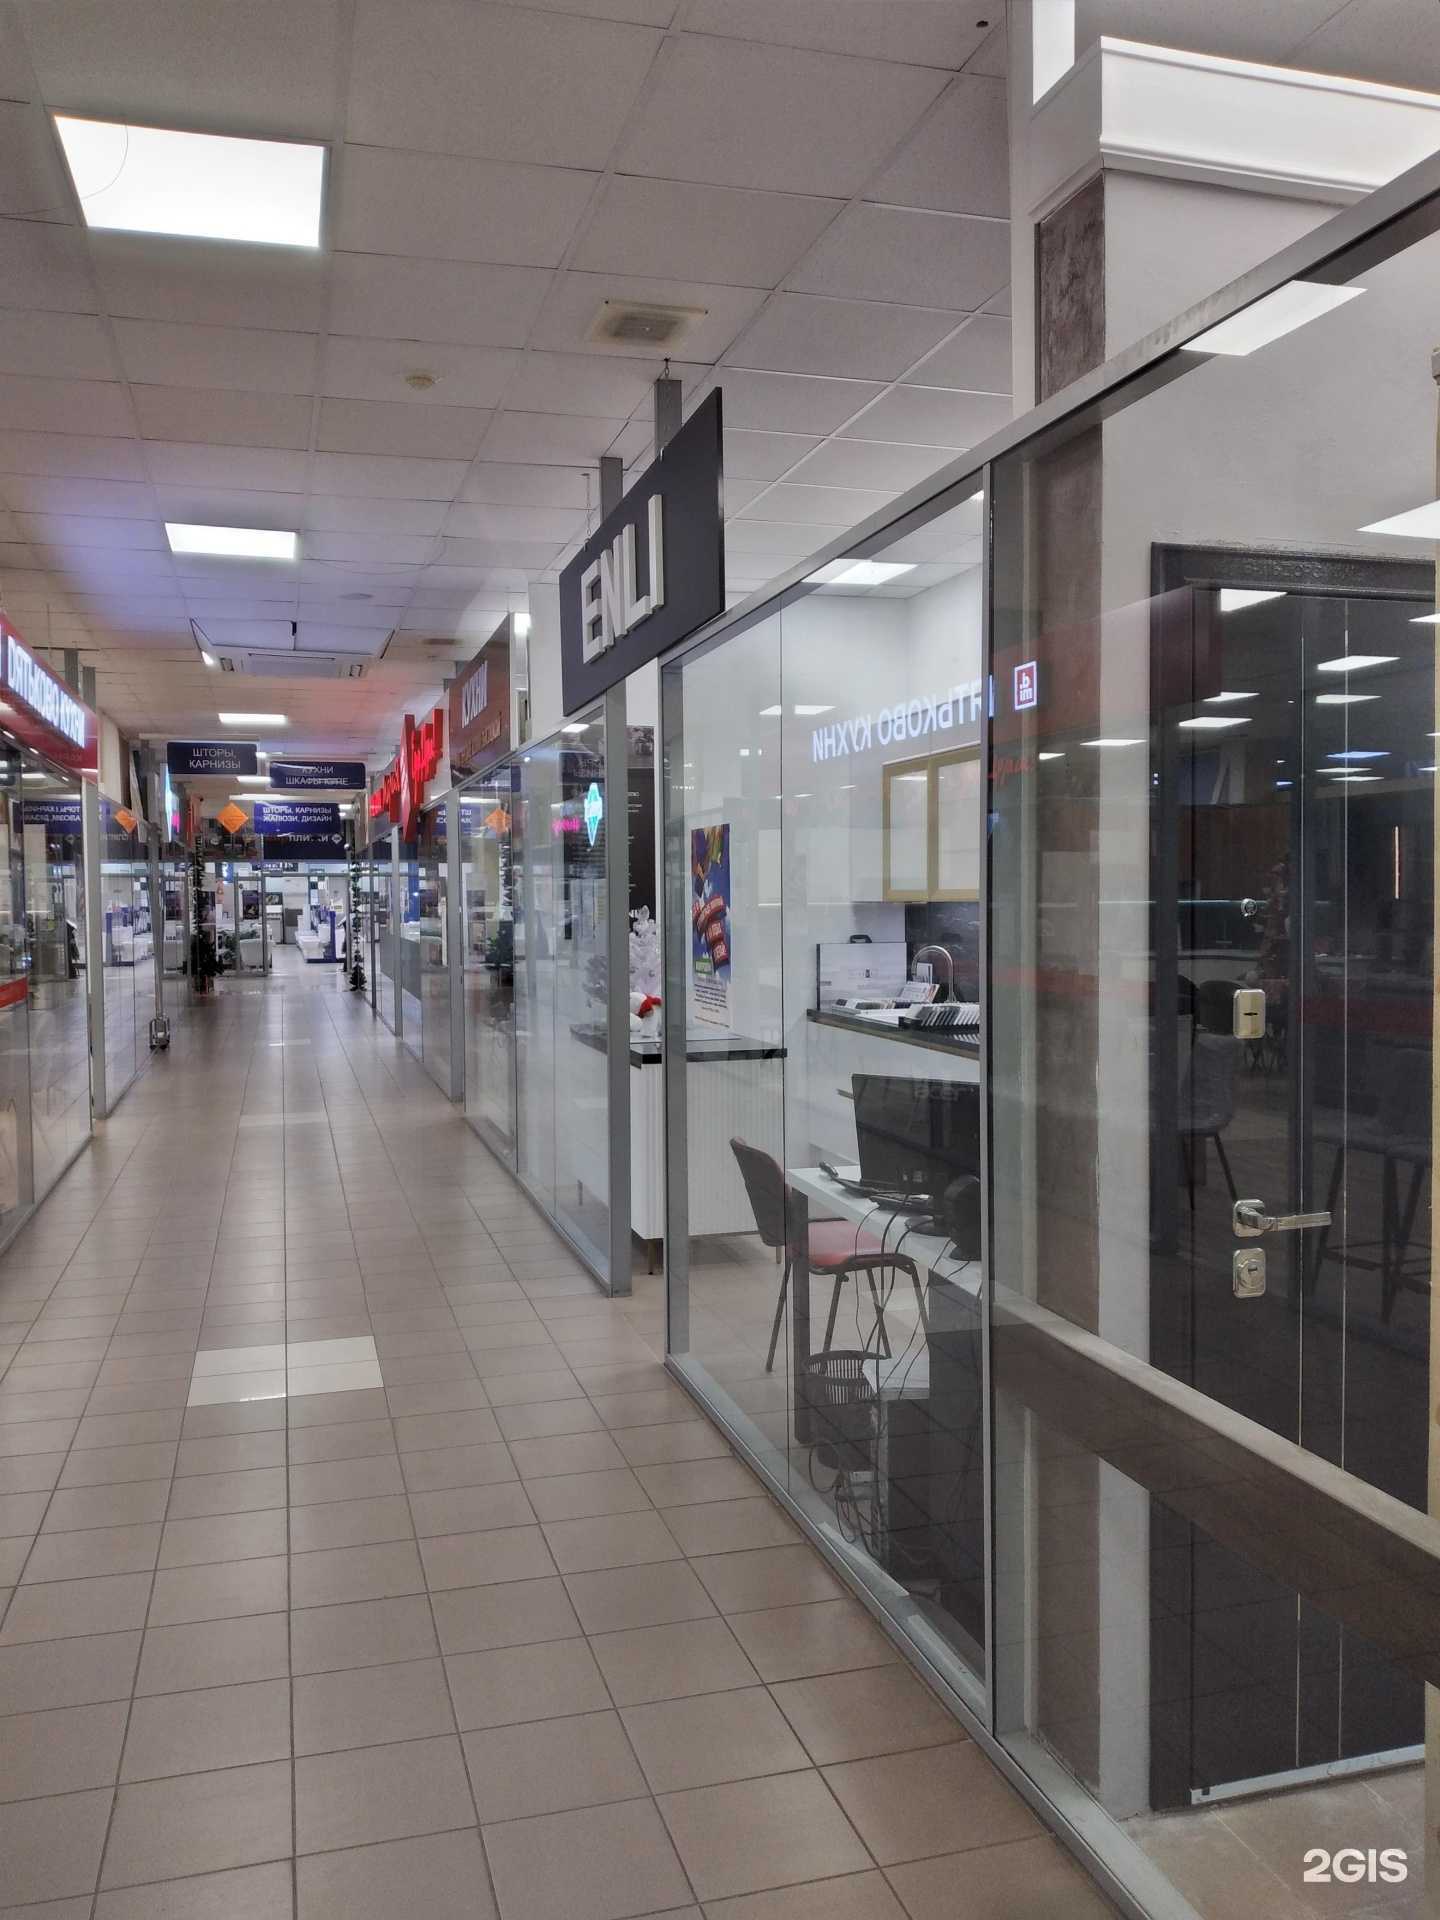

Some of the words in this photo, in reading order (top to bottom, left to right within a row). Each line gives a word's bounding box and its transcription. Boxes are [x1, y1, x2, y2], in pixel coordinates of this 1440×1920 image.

[461, 660, 488, 729] КУХНИ
[192, 748, 237, 759] ШТОРЫ,
[189, 759, 241, 769] КАРНИЗЫ
[262, 806, 294, 814] ШТОРЫ,
[295, 806, 332, 814] КАРНИЗЫ
[301, 814, 333, 823] ДИЗАЙН
[288, 833, 329, 843] ПЛИИ
